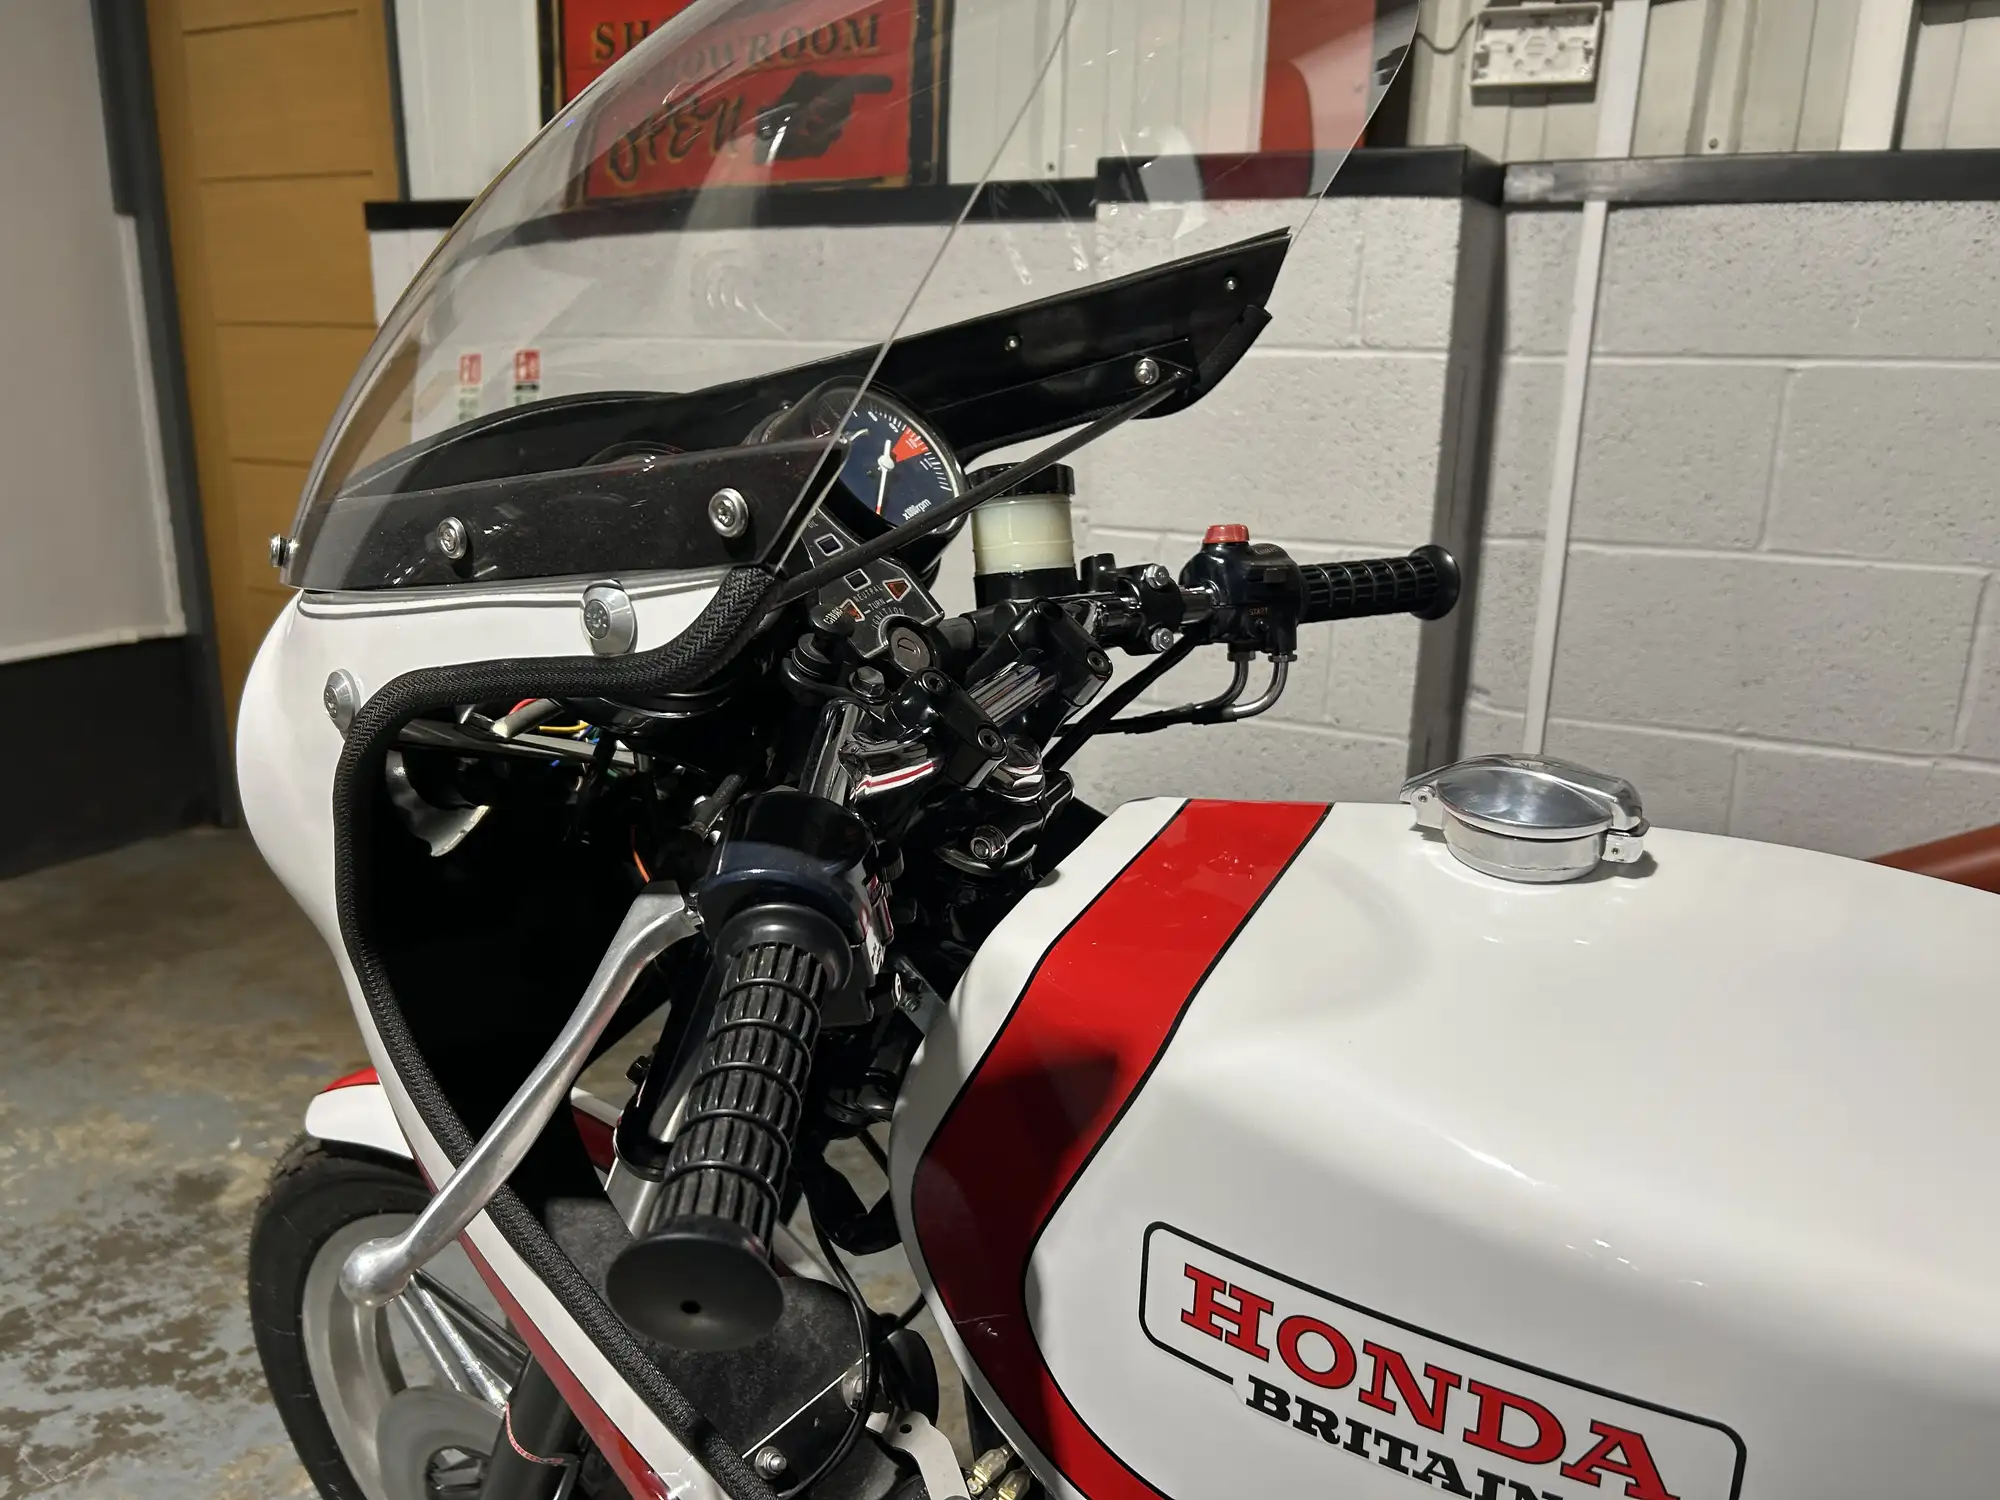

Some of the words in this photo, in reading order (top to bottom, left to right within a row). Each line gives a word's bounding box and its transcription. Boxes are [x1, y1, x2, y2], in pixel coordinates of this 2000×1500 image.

[852, 584, 883, 602] NEUTRAL
[867, 598, 886, 610] TURN
[871, 606, 905, 629] IGNITION
[1181, 1263, 1681, 1500] HONDA
